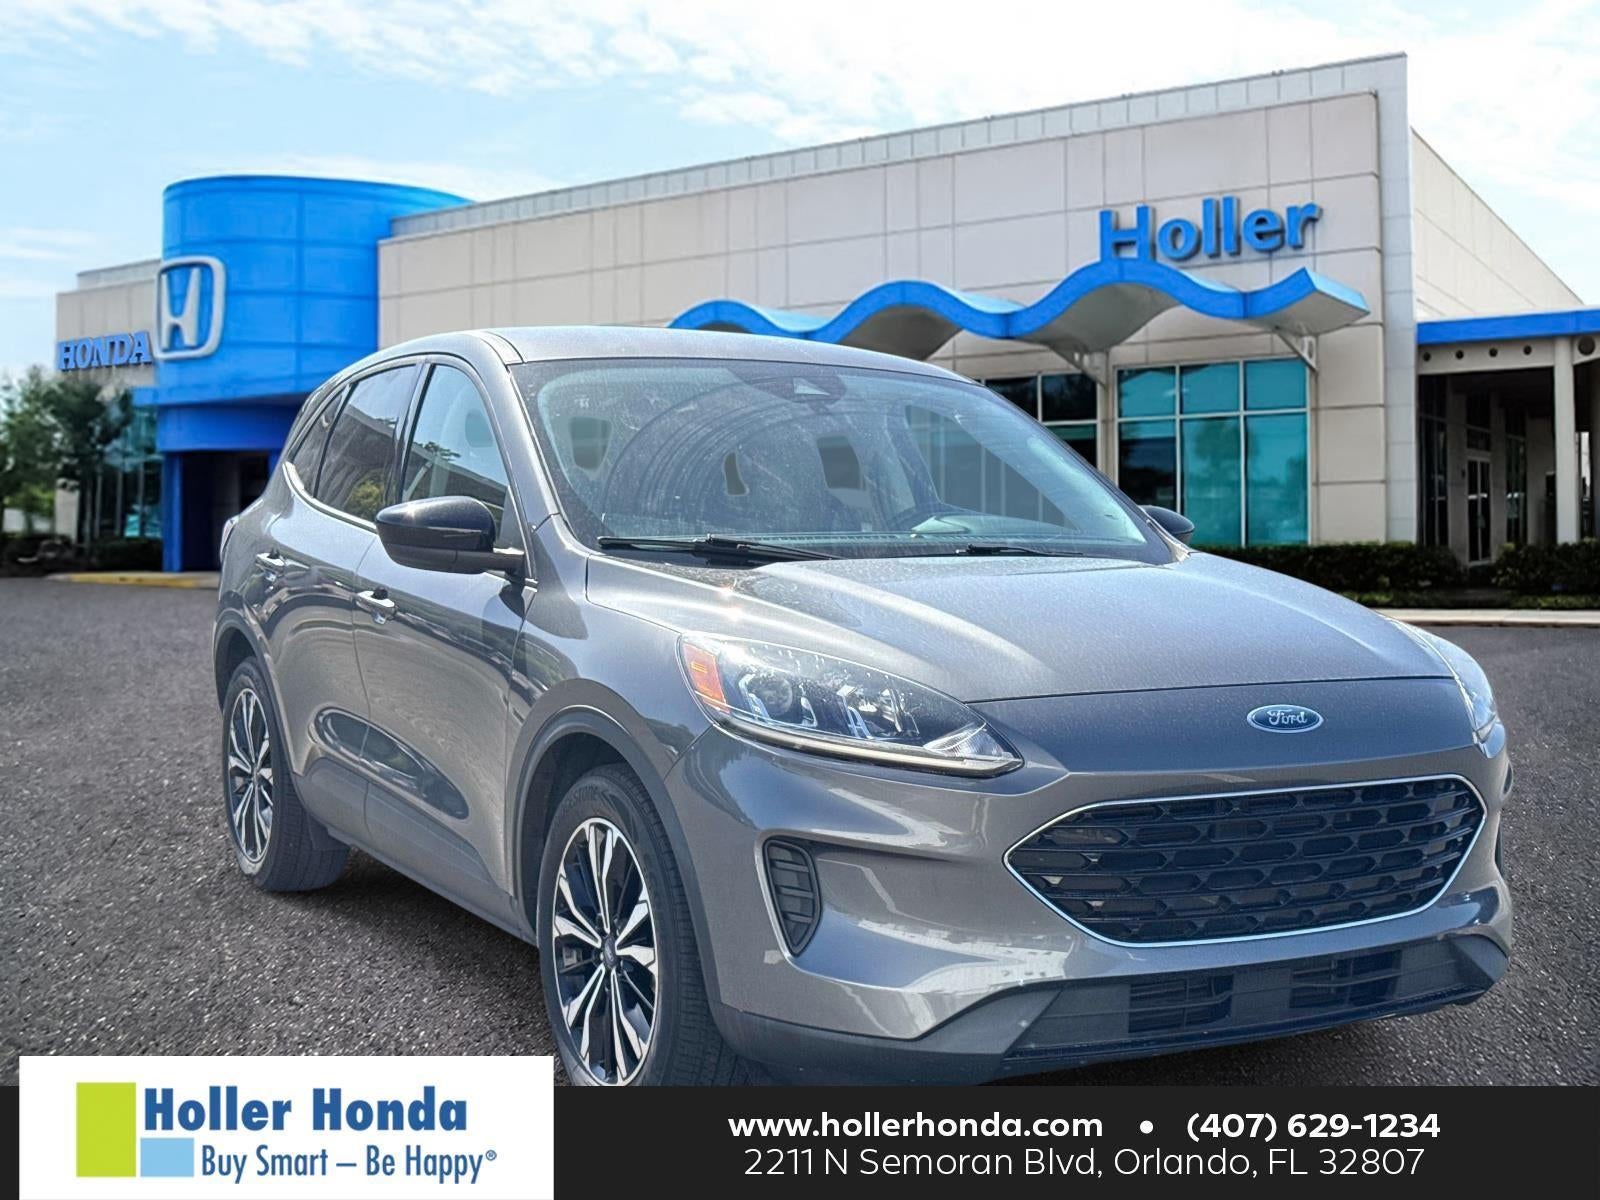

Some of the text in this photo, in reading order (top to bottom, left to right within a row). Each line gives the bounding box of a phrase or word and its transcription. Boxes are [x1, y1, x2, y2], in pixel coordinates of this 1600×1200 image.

[1099, 195, 1322, 261] Holler
[57, 331, 152, 371] HONDA
[1267, 709, 1308, 725] Ford
